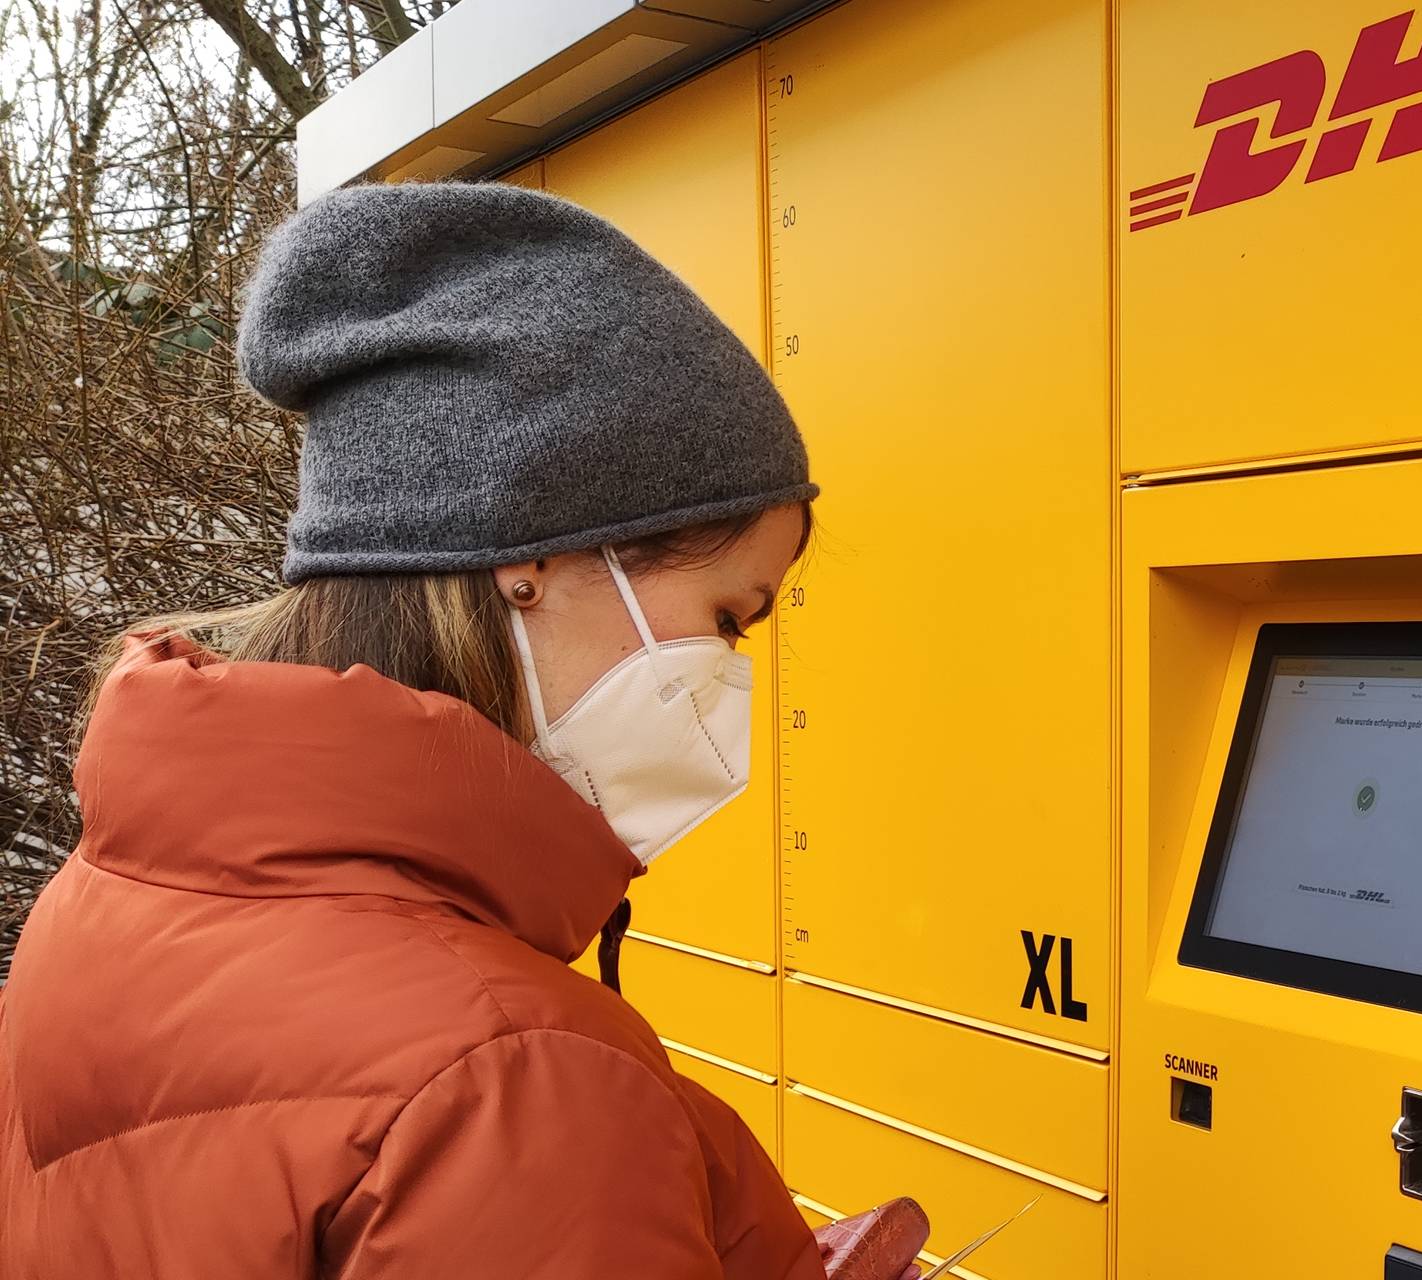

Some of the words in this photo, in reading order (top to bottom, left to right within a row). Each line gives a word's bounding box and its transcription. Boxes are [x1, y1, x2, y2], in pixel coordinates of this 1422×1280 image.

[779, 74, 794, 98] 70
[782, 205, 797, 229] 60
[785, 333, 800, 357] 50
[790, 587, 805, 607] 30
[792, 709, 807, 730] 20
[793, 830, 808, 852] 10
[795, 928, 810, 944] cm
[1020, 929, 1088, 1022] XL
[1164, 1053, 1219, 1081] SCANNER
